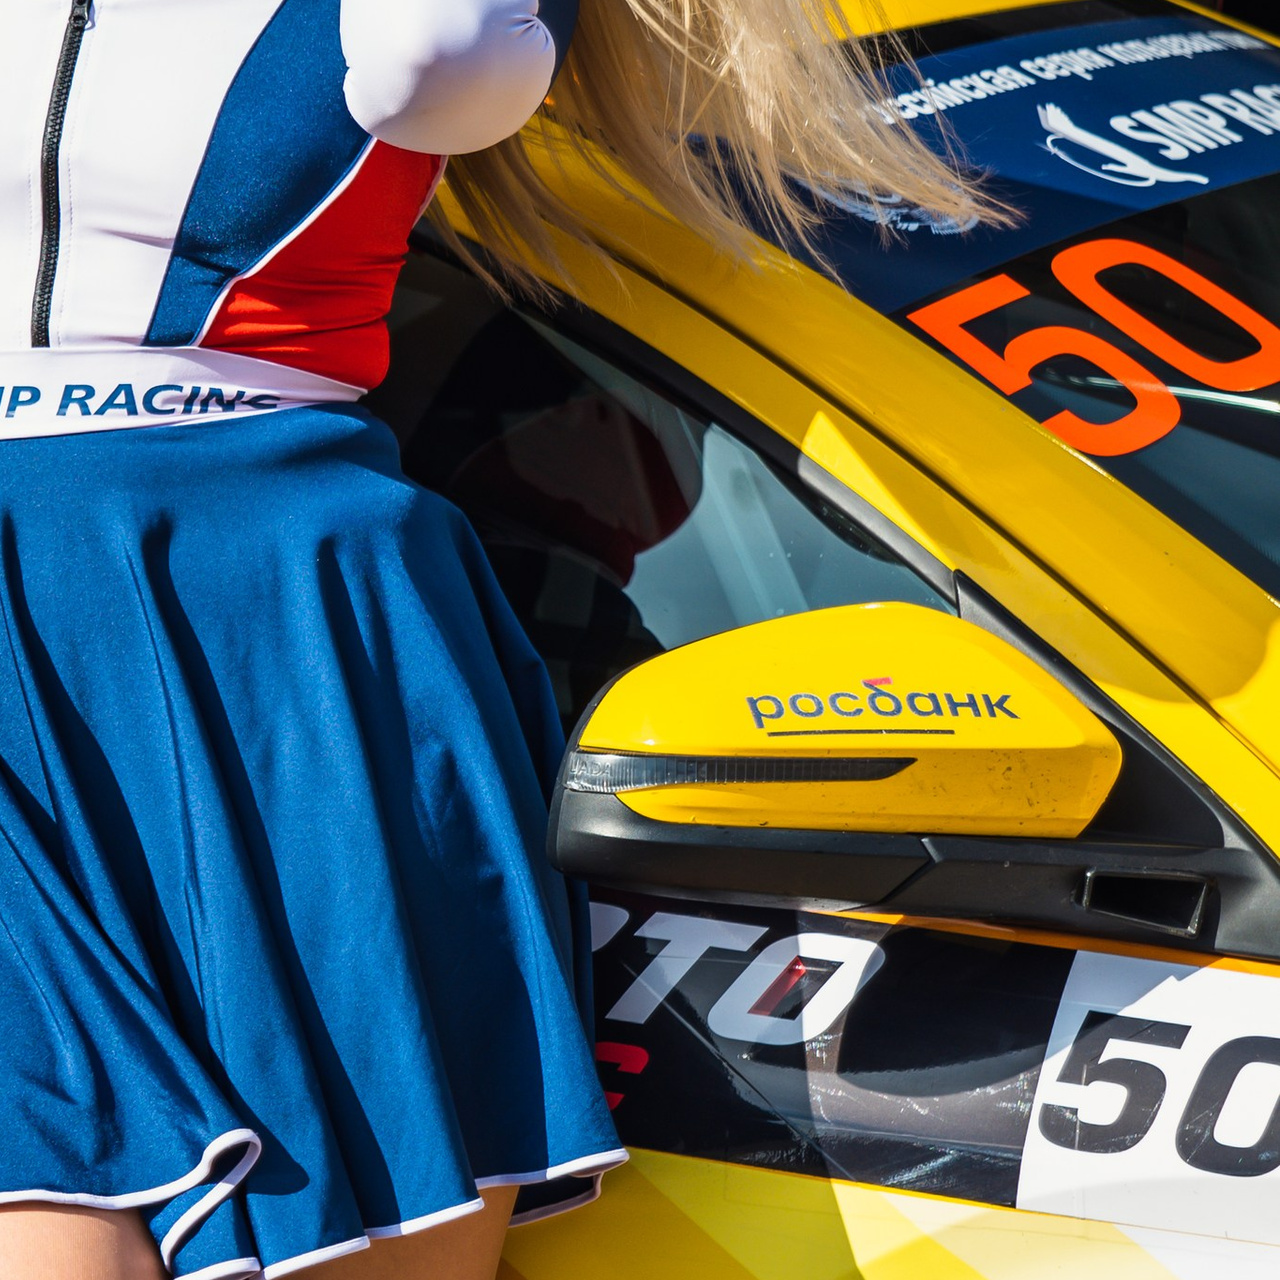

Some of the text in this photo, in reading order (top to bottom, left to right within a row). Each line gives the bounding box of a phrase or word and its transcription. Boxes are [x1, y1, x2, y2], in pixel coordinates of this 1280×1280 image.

[1109, 99, 1244, 161] SMP
[907, 238, 1280, 456] 50
[746, 677, 1021, 729] росбанк
[1038, 1010, 1280, 1178] 50
